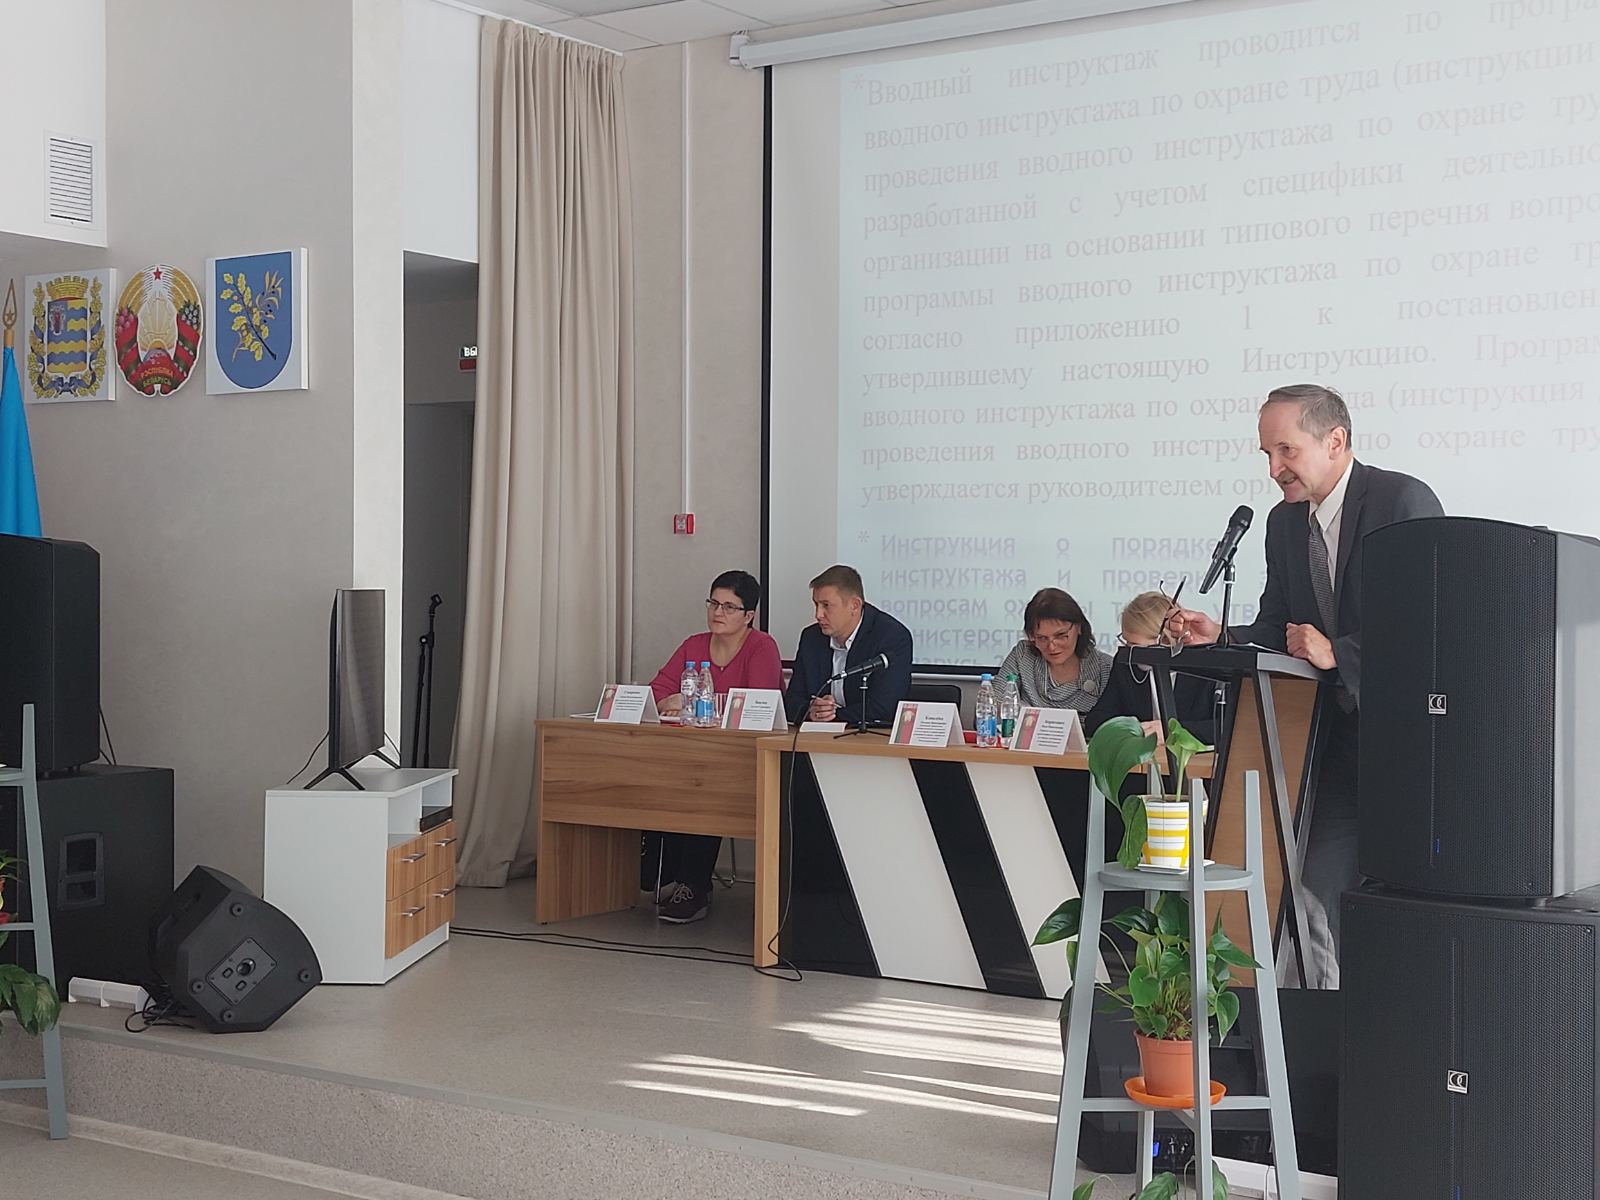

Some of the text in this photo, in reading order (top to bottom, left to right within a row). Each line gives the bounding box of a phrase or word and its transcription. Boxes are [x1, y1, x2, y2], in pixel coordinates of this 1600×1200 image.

[867, 67, 973, 105] Вводный
[1007, 49, 1160, 89] инструктаж
[1198, 20, 1361, 68] проводится
[1404, 9, 1443, 35] по
[864, 119, 969, 151] вводного
[978, 97, 1140, 137] инструктажа
[1151, 93, 1183, 117] по
[1194, 79, 1289, 114] охране
[1300, 65, 1381, 104] труда
[864, 159, 1000, 198] проведения
[1017, 144, 1134, 177] вводного
[1154, 121, 1335, 162] инструктажа
[1357, 114, 1394, 139] по
[1416, 98, 1526, 138] охране
[863, 193, 1038, 240] разработанной
[1068, 195, 1083, 214] с
[1112, 181, 1209, 218] учетом
[1242, 160, 1404, 197] специфики
[863, 243, 1011, 280] организации
[1024, 240, 1053, 263] на
[1065, 227, 1206, 259] основании
[1220, 213, 1352, 247] типового
[1367, 200, 1491, 237] перечня
[863, 287, 996, 319] программы
[1017, 277, 1133, 304] вводного
[1157, 260, 1338, 296] инструктажа
[1364, 255, 1402, 279] по
[1430, 243, 1540, 279] охране
[862, 329, 963, 352] согласно
[1014, 316, 1181, 350] приложению
[1241, 305, 1253, 330] 1
[1316, 305, 1335, 326] к
[862, 365, 1034, 397] утвердившему
[1061, 356, 1210, 384] настоящую
[1240, 344, 1438, 376] Инструкцию.
[862, 404, 966, 429] вводного
[975, 399, 1137, 429] инструктажа
[1145, 399, 1179, 419] по
[1388, 381, 1586, 415] (инструкция
[862, 443, 996, 471] проведения
[1016, 441, 1130, 463] вводного
[1357, 432, 1392, 451] по
[1417, 427, 1528, 456] охране
[861, 479, 1020, 508] утверждается
[1028, 477, 1223, 505] руководителем
[881, 534, 1016, 556] Инструкция
[1056, 537, 1071, 552] о
[881, 568, 1027, 588] инструктажа
[1056, 569, 1072, 585] и
